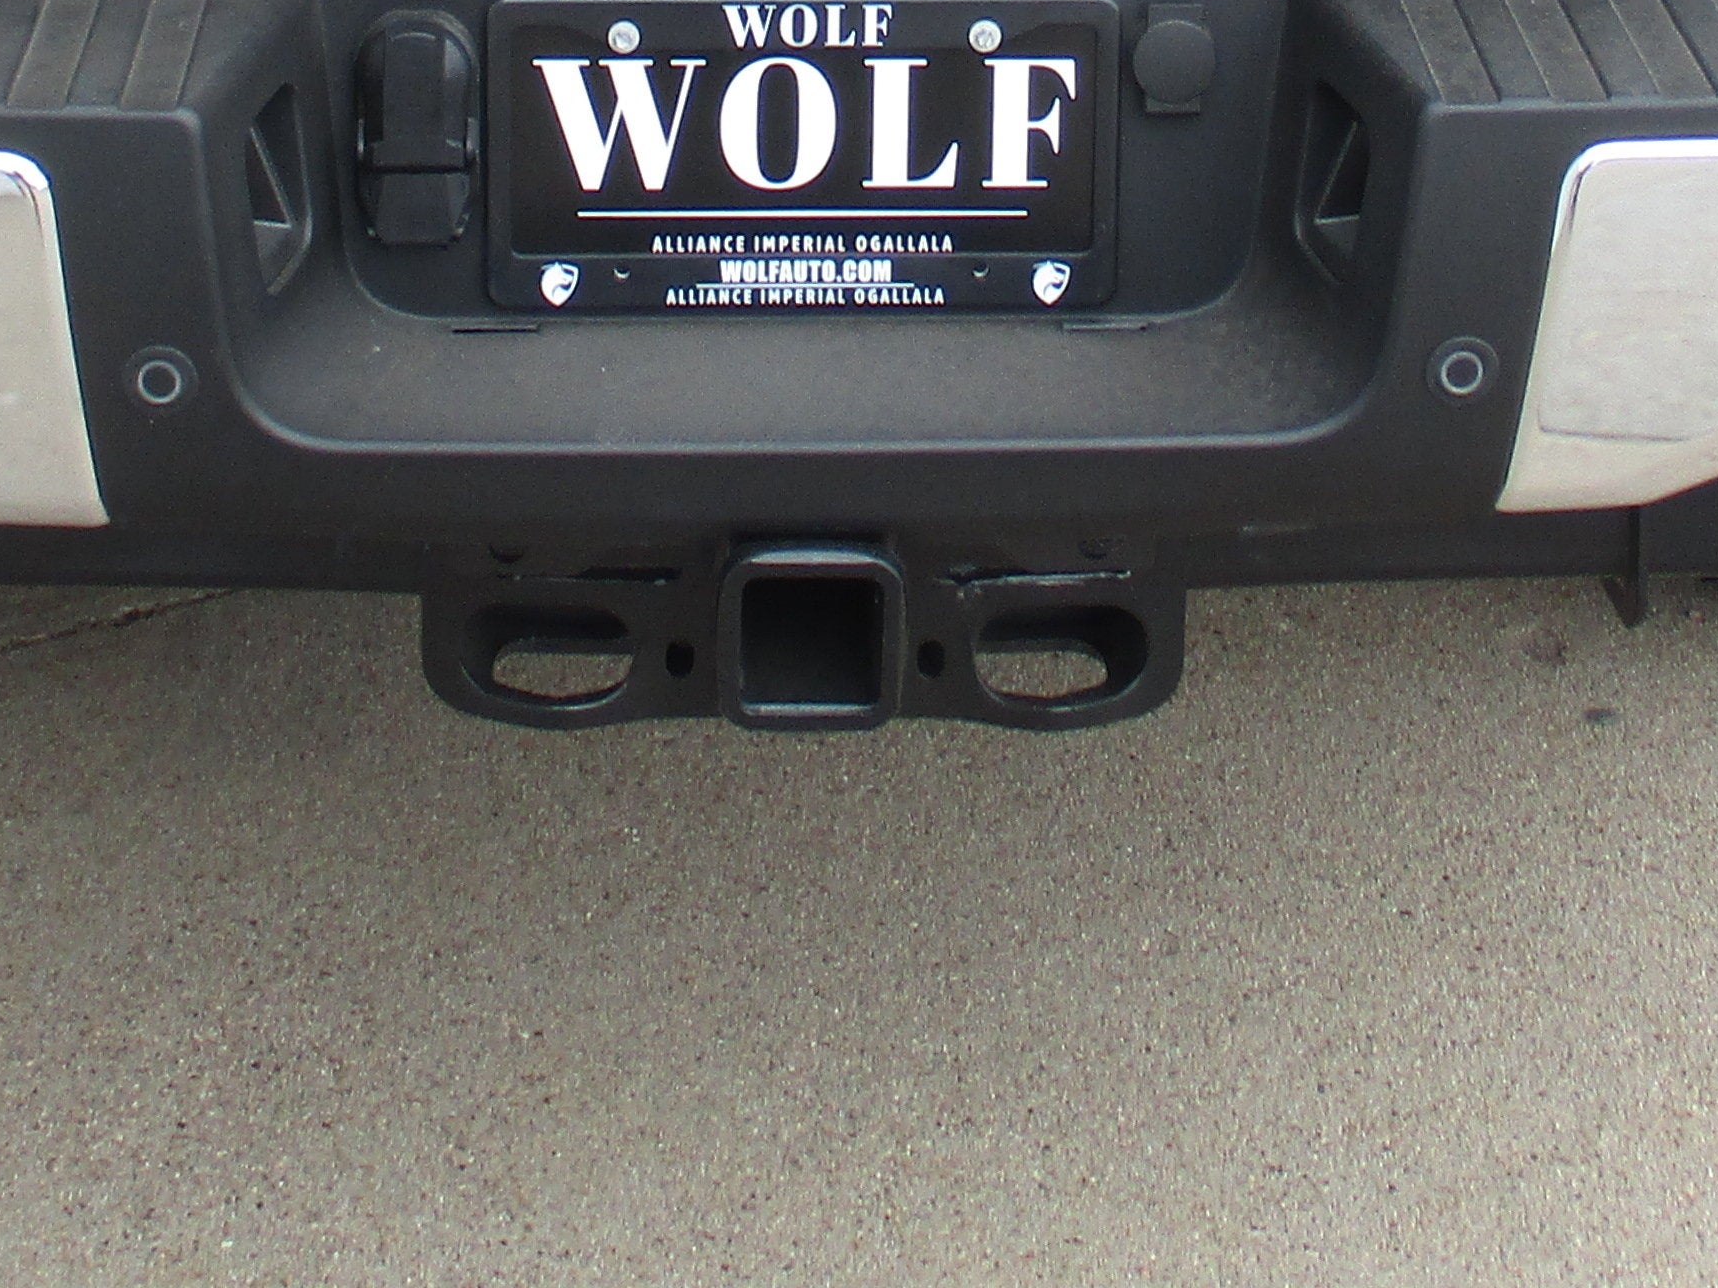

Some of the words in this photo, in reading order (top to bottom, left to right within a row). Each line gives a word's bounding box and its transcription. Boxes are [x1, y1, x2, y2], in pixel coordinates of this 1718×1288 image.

[721, 3, 894, 48] WOLF
[531, 56, 1077, 191] WOLF
[651, 235, 746, 254] ALLIANCE
[753, 235, 847, 253] IMPERIAL
[854, 235, 954, 253] OGALLALA
[719, 260, 892, 283] WOLFAUTO.COM
[665, 288, 751, 306] ALLIANCE
[757, 288, 846, 306] IMPERIAL
[853, 288, 945, 306] OGALLALA
